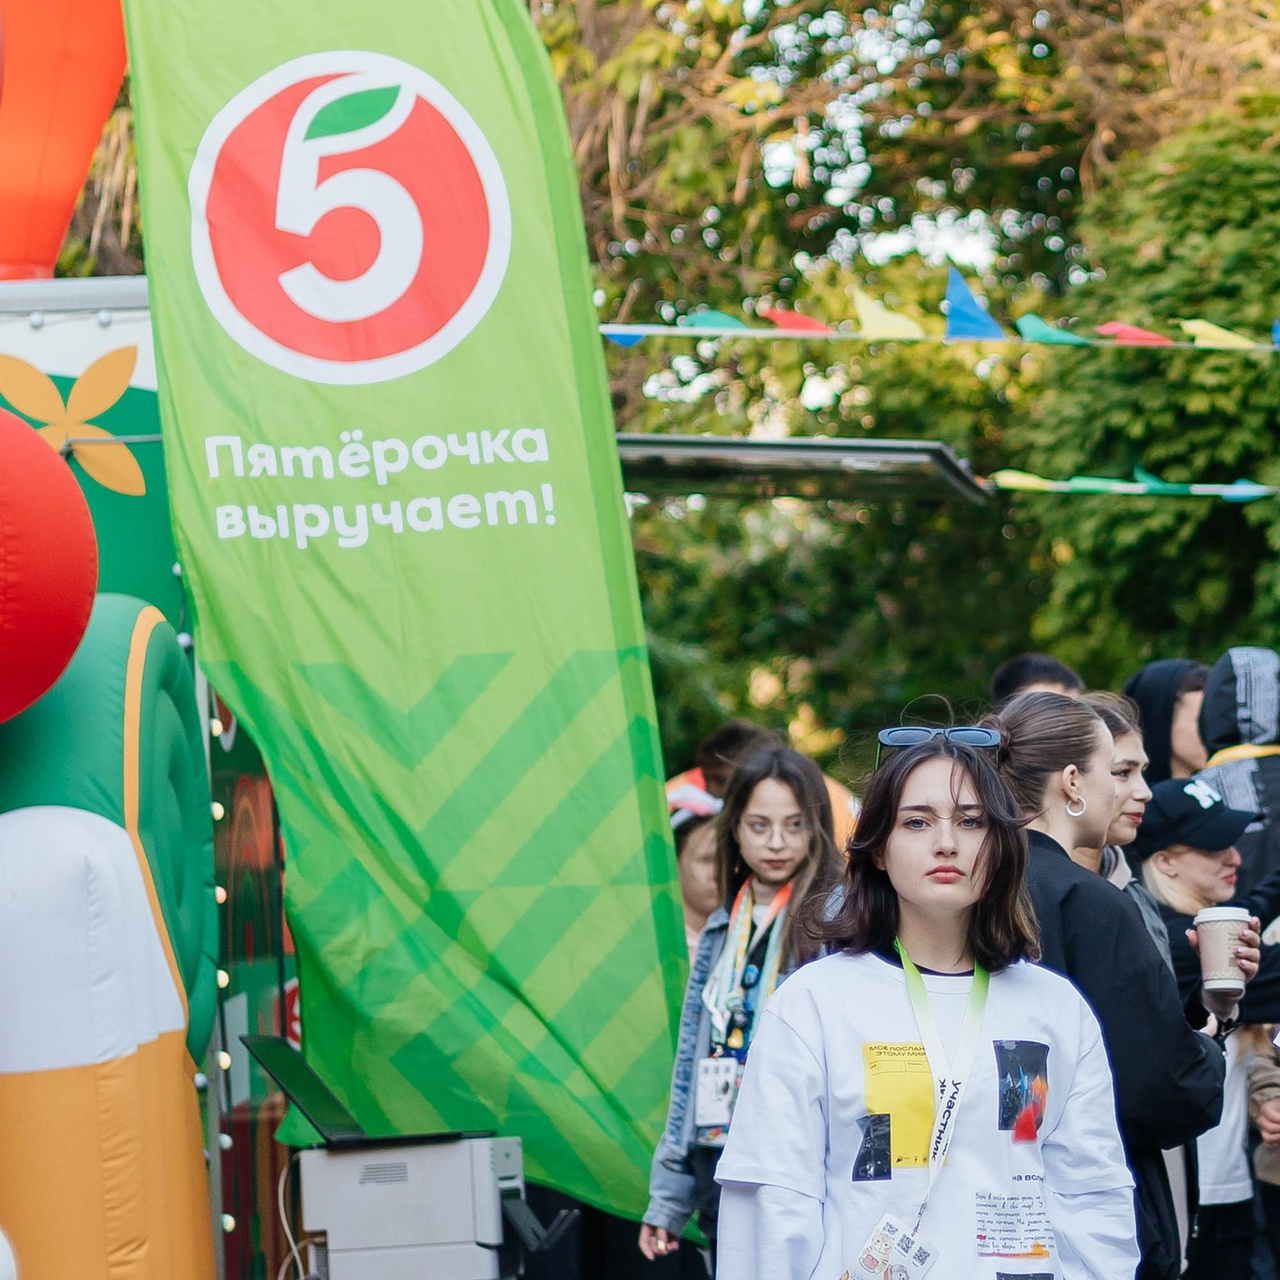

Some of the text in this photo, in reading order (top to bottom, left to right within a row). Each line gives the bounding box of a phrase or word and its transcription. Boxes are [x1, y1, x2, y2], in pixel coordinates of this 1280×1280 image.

[204, 428, 550, 485] Пятёрочка
[215, 483, 557, 549] выручает!
[931, 1079, 962, 1162] участник
